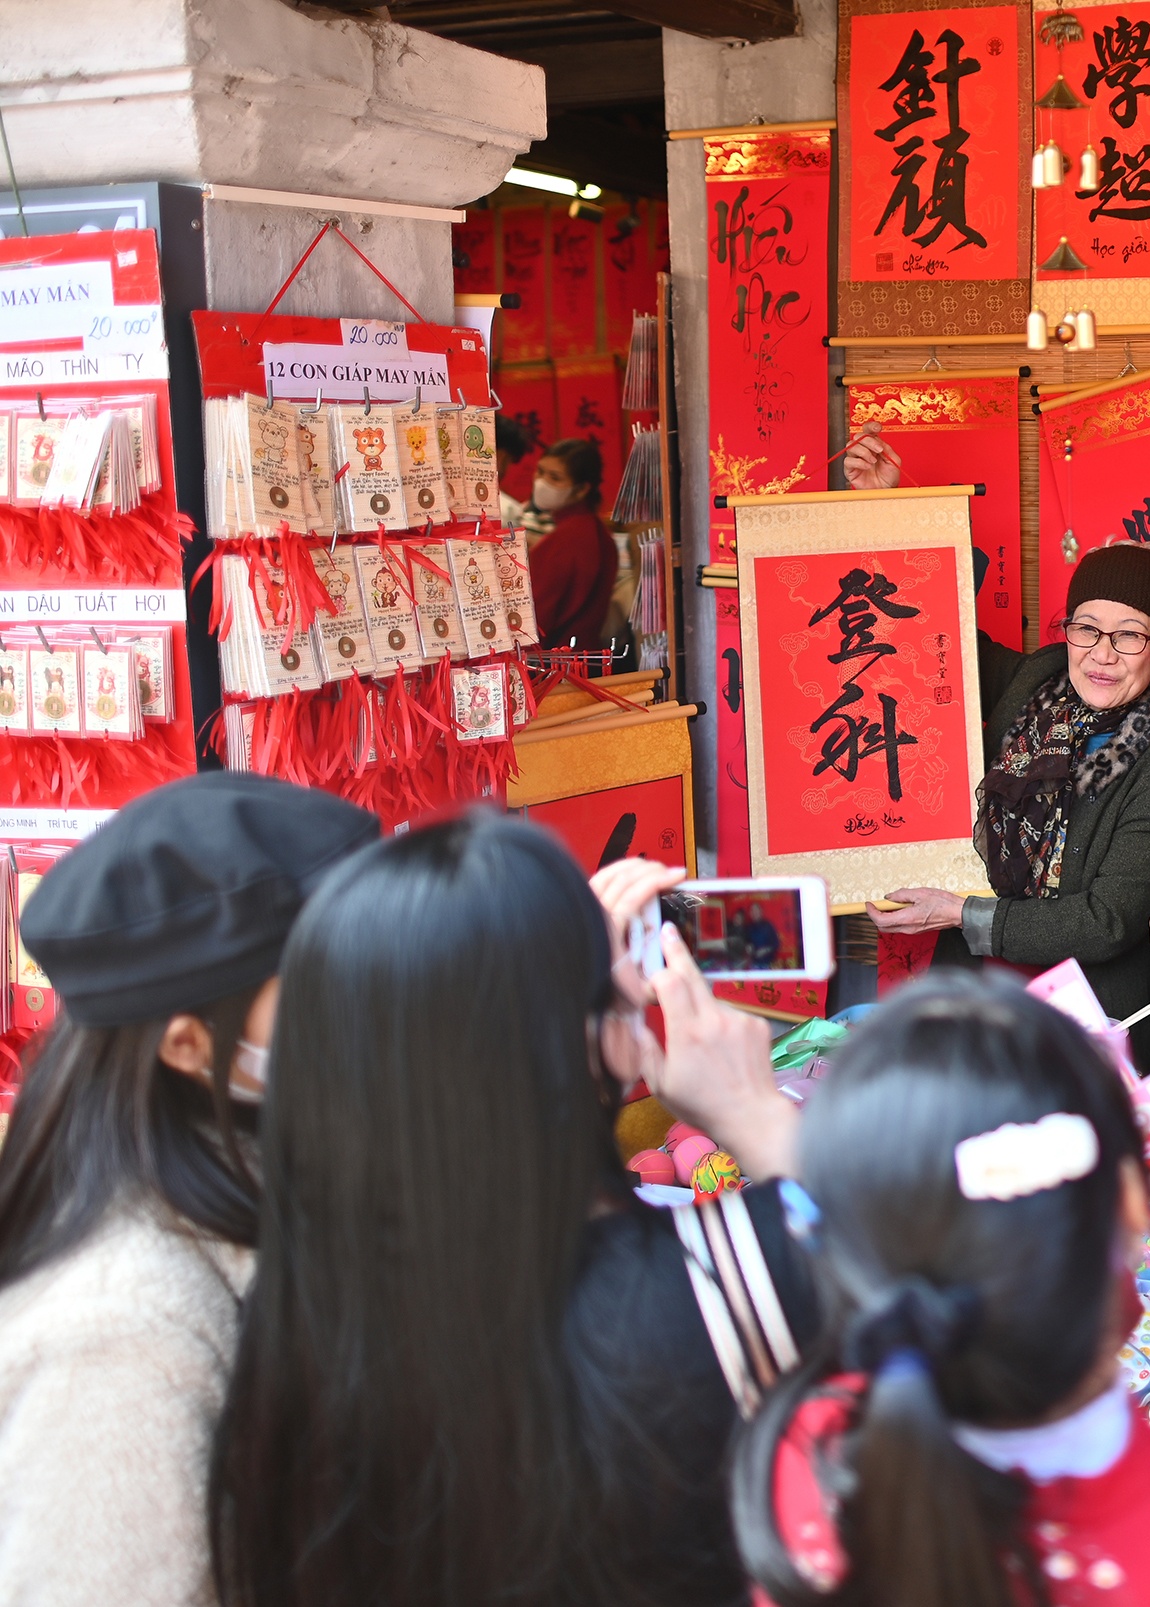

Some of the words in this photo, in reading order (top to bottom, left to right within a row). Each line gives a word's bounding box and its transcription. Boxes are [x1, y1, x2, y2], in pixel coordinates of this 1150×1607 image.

[1090, 238, 1115, 257] Học
[1, 288, 42, 307] MAY
[7, 358, 44, 378] MÃO
[60, 355, 99, 376] THÌN
[269, 361, 286, 378] 12
[290, 362, 328, 380] CON
[332, 363, 372, 382] GIÁP
[376, 367, 410, 385] MAY
[413, 367, 447, 386] MẮN
[27, 594, 61, 615] DẬU
[75, 592, 117, 612] TUẤT
[135, 594, 166, 615] HỢI
[809, 569, 921, 802] 登科
[16, 819, 37, 828] MINH
